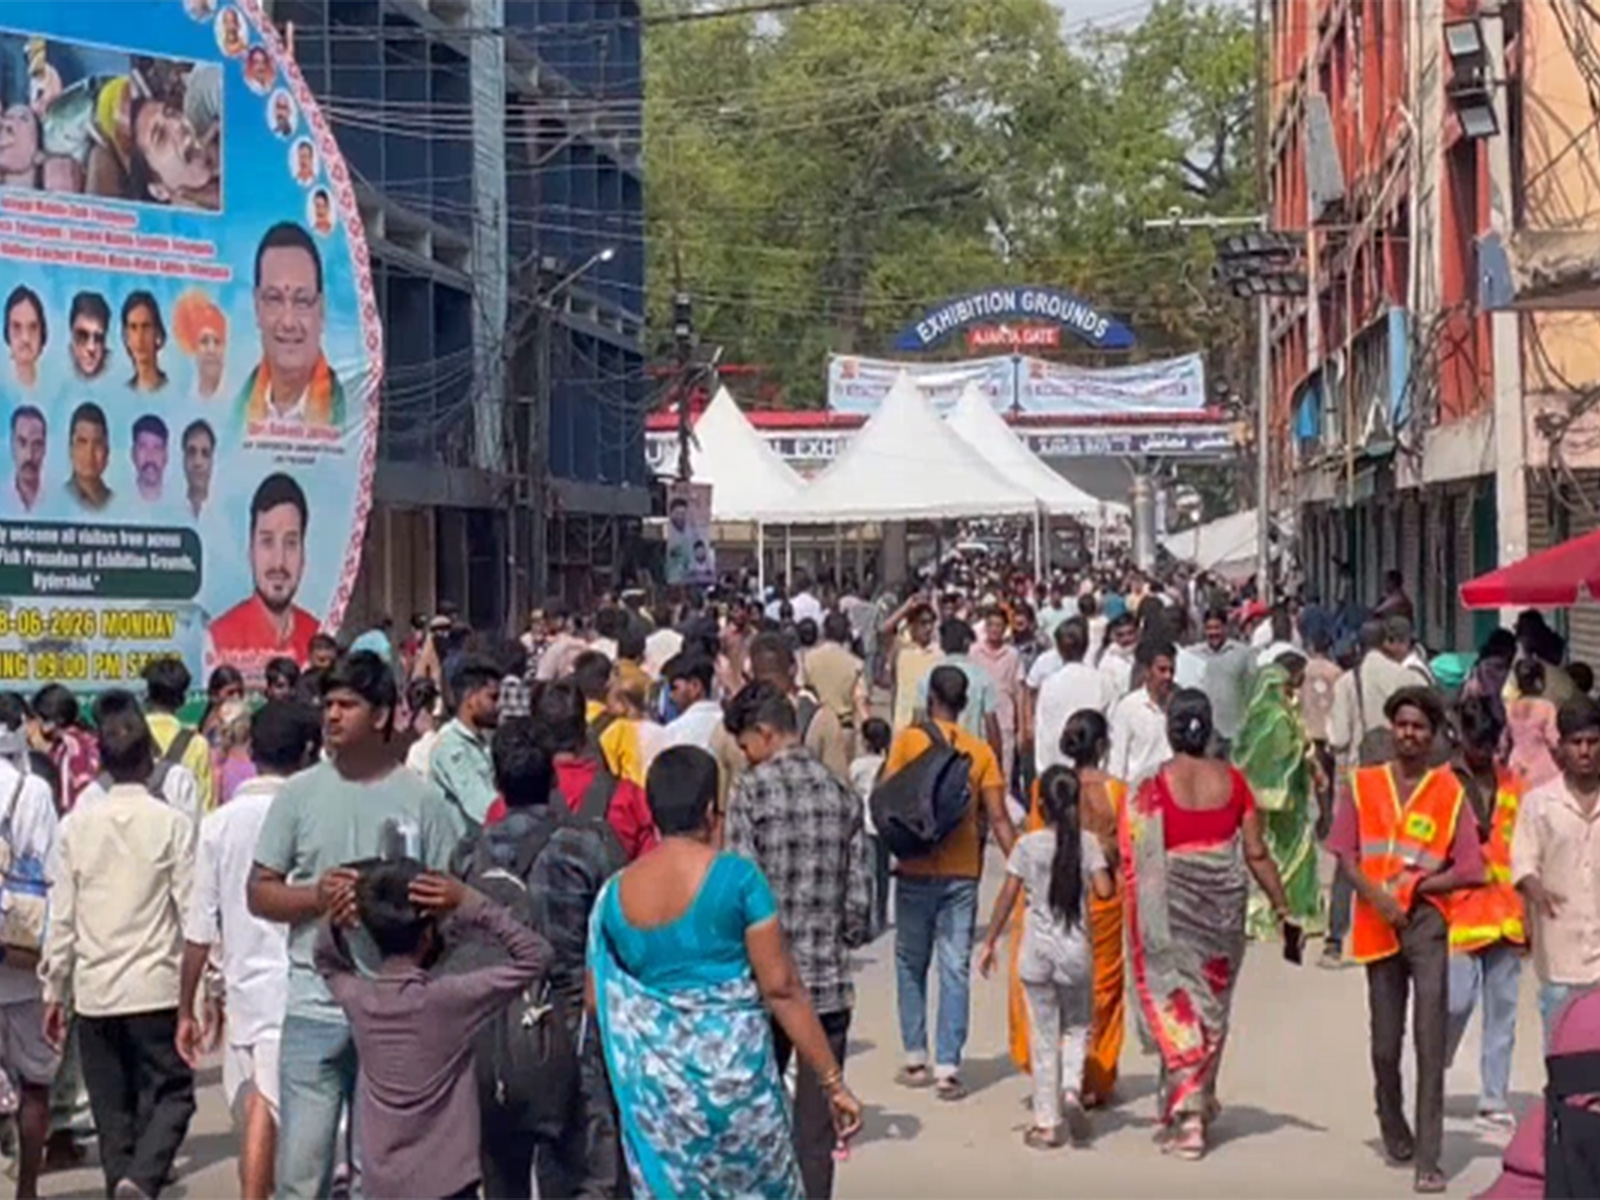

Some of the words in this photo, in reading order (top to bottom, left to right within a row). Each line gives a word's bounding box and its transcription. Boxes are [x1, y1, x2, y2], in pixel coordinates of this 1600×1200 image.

[915, 290, 1016, 343] EXHIBITION
[1021, 290, 1109, 339] GROUNDS
[61, 527, 76, 544] all
[96, 550, 148, 569] Exhibition
[101, 609, 176, 639] MONDAY
[92, 652, 123, 680] PM
